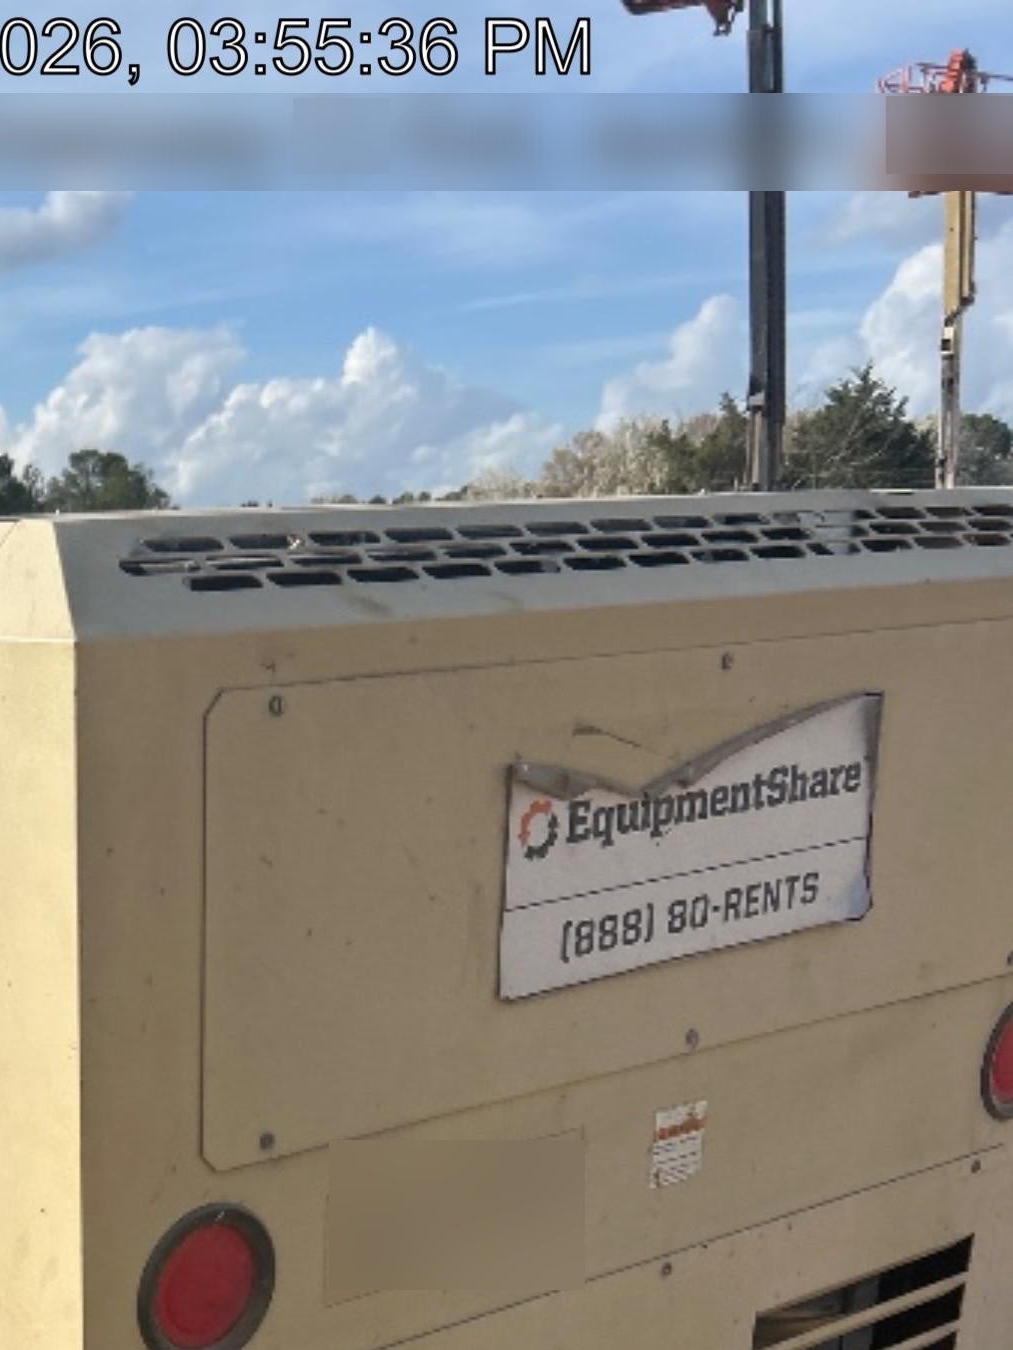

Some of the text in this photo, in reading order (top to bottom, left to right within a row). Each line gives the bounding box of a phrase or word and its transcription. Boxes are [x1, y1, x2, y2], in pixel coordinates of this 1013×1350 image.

[565, 760, 863, 849] EquipmentShare
[559, 871, 820, 964] (888) 80-RENTS
